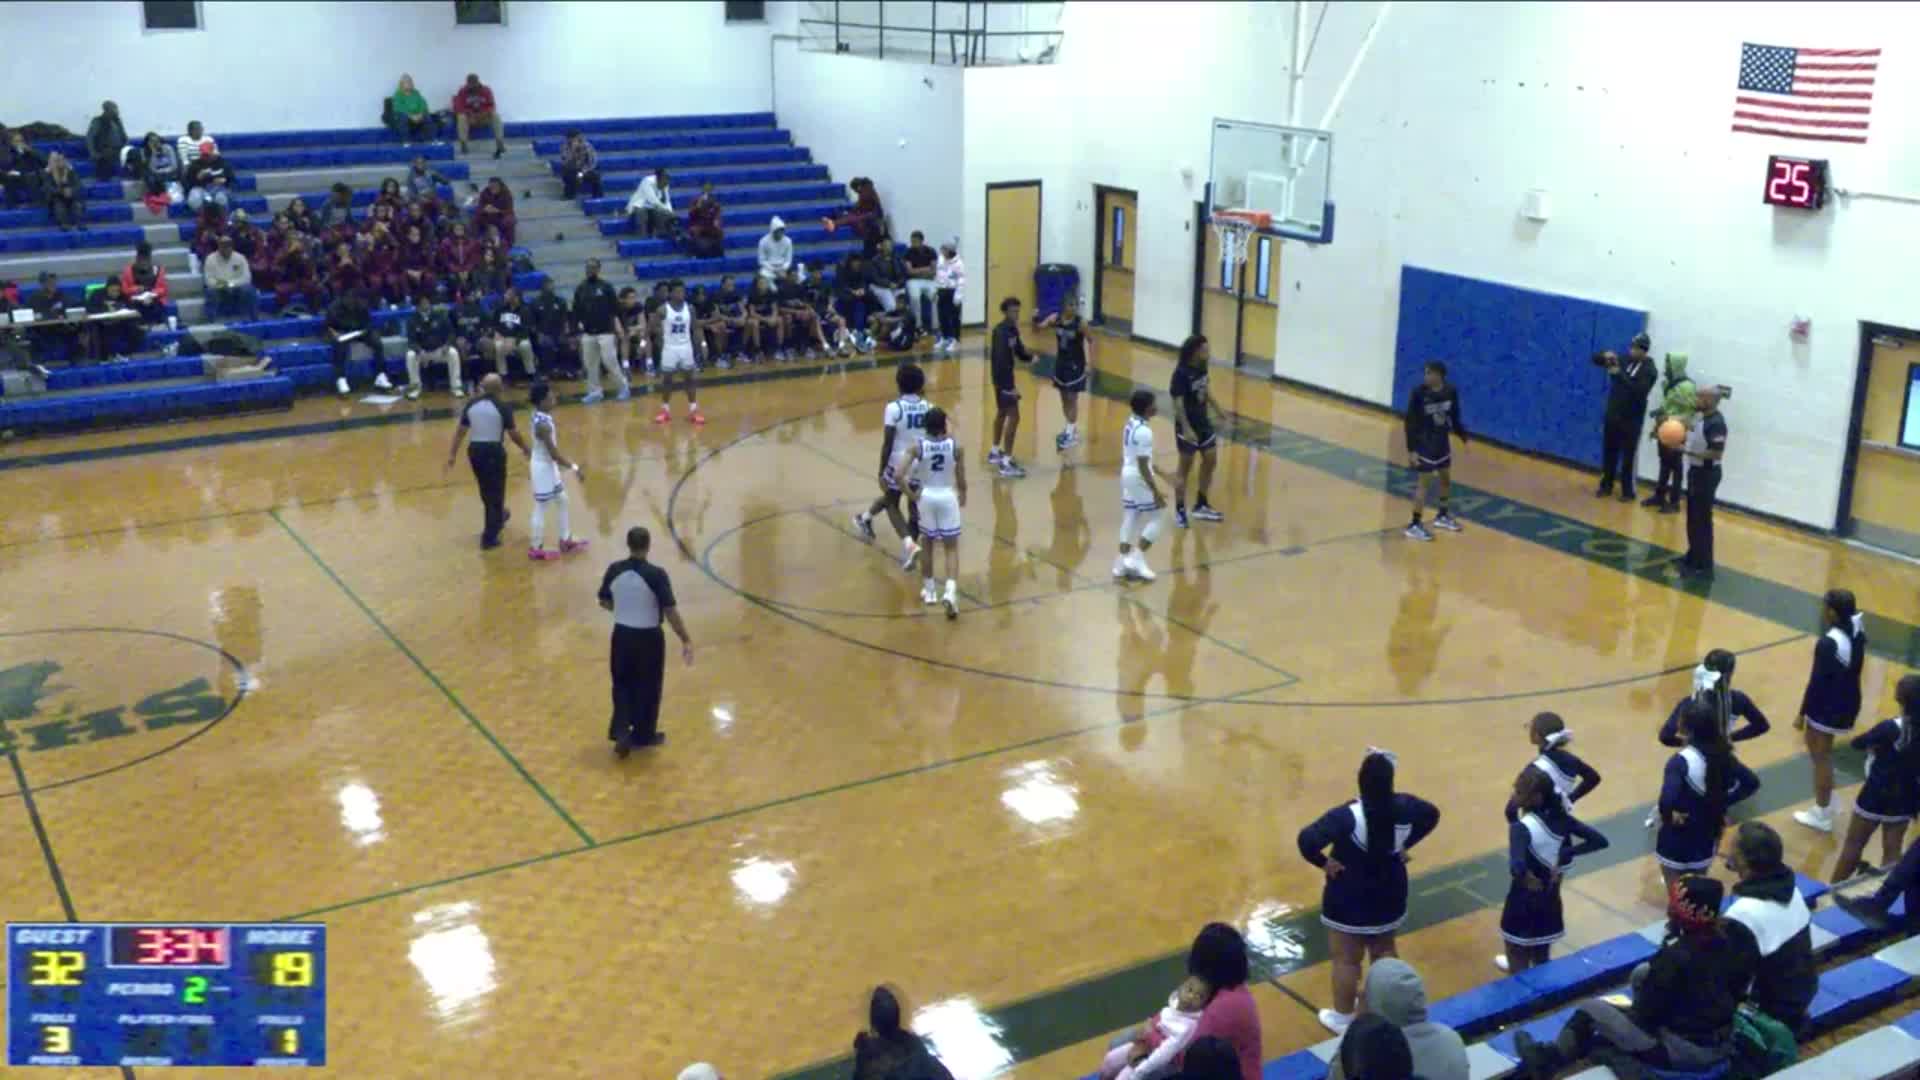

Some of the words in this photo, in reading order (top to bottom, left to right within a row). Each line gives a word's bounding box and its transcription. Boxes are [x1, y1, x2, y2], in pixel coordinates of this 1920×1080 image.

[1769, 162, 1809, 202] 25
[671, 324, 686, 334] 22
[907, 413, 927, 430] 10
[930, 453, 945, 472] 2
